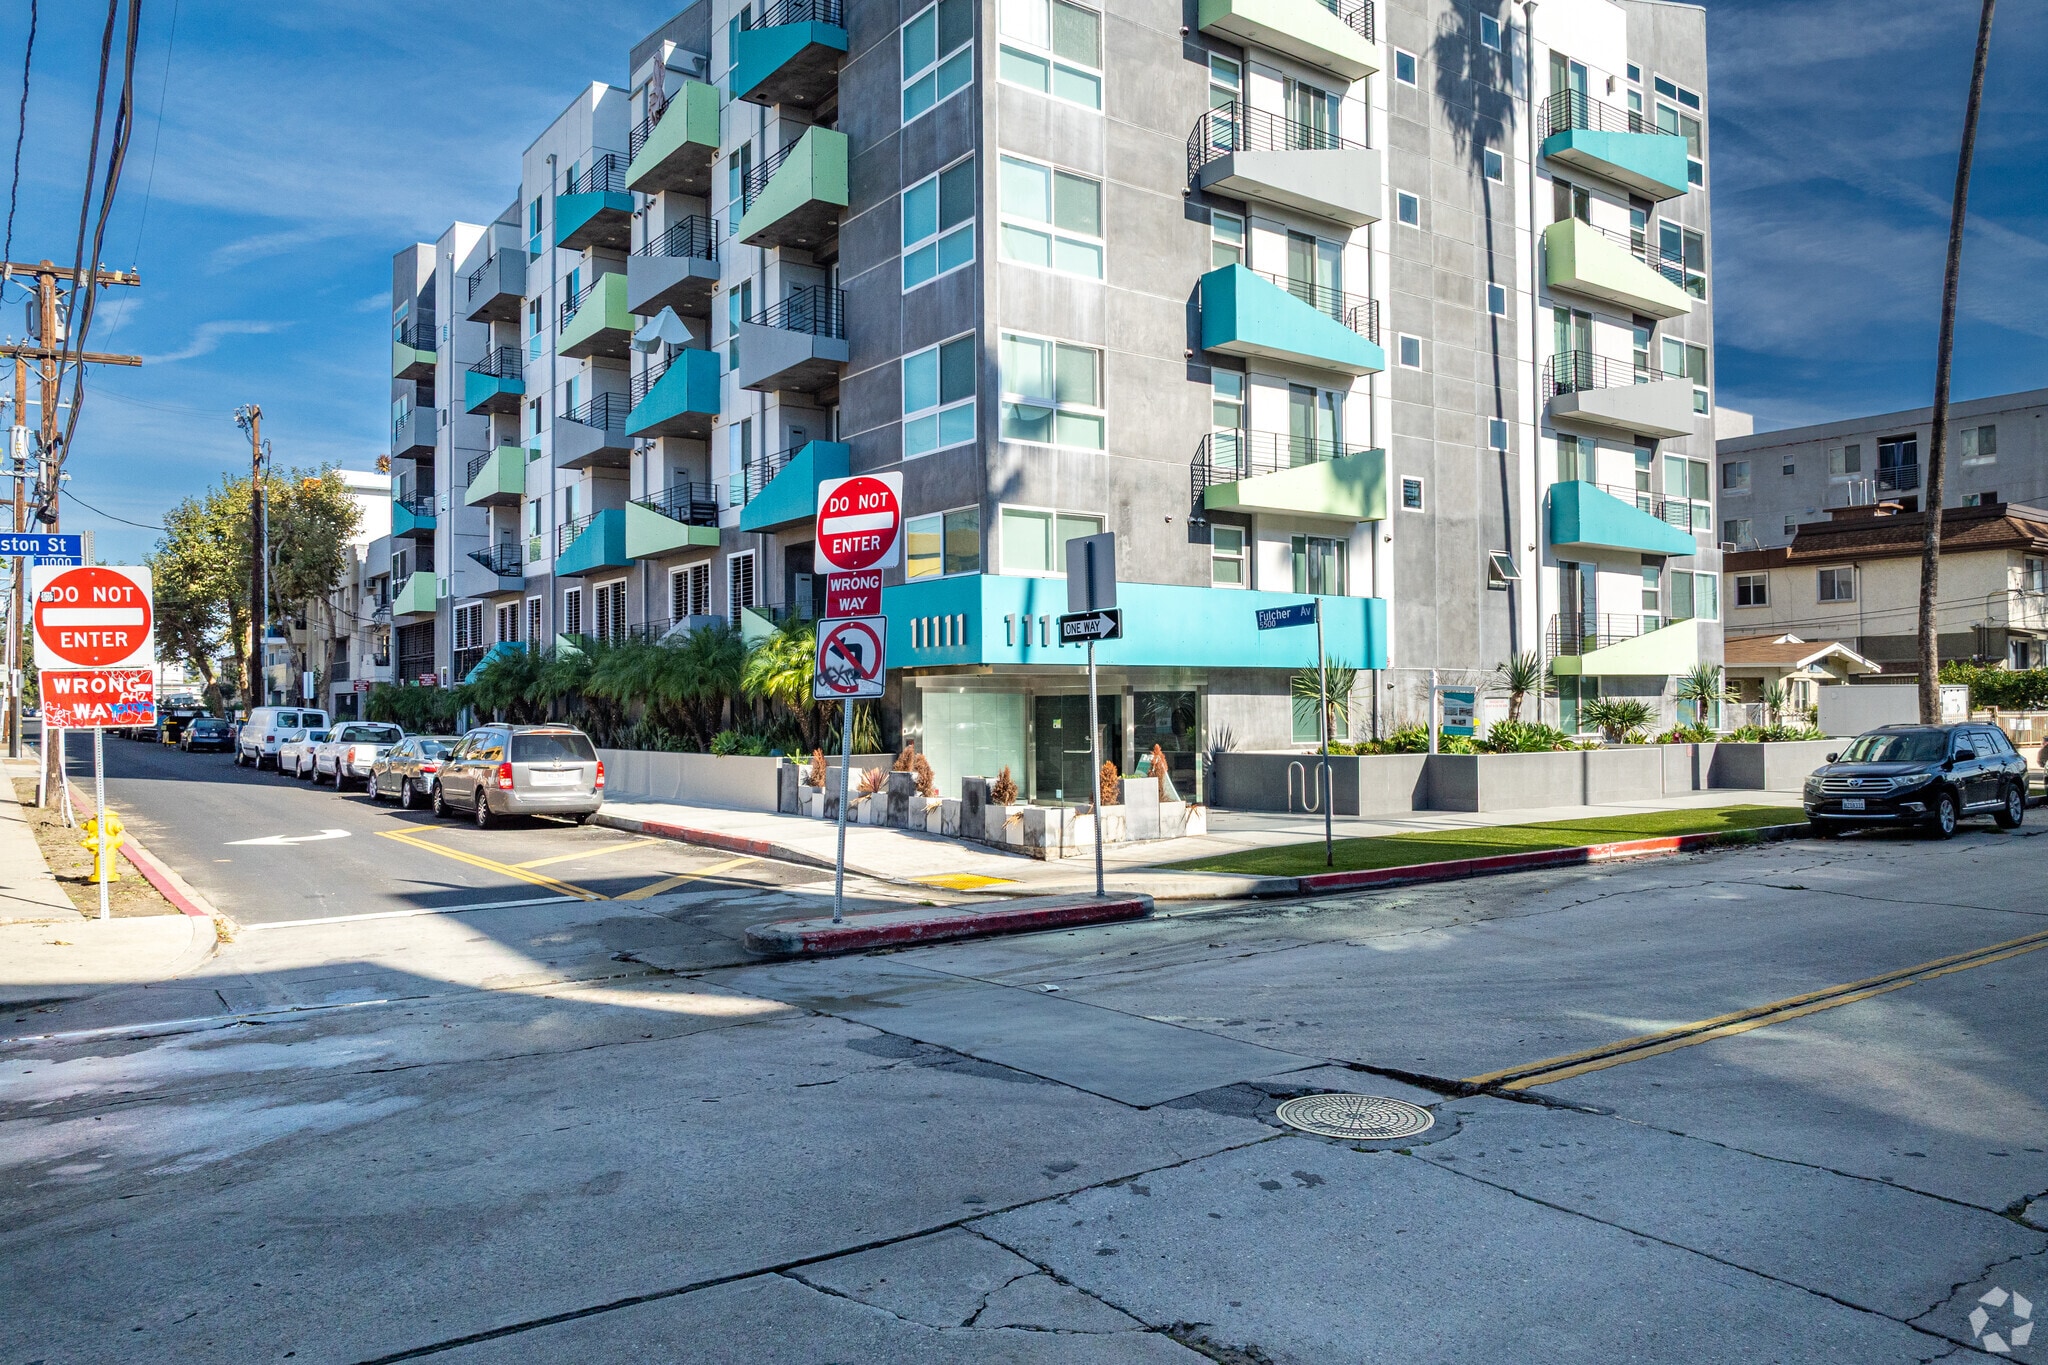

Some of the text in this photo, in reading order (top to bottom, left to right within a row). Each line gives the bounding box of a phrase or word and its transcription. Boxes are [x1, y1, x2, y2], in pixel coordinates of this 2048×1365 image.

[830, 492, 889, 513] DO NOT
[1, 537, 66, 552] ston St
[832, 535, 880, 554] ENTER
[830, 575, 880, 592] WRONG
[51, 586, 79, 603] DO
[92, 586, 134, 603] NOT
[839, 596, 868, 611] WAY
[1259, 606, 1311, 622] Fulcher Av
[910, 613, 964, 649] 11111
[1065, 620, 1100, 635] ONE WAY
[1260, 620, 1276, 629] 5500
[60, 631, 128, 648] ENTER
[53, 677, 141, 694] WRONG
